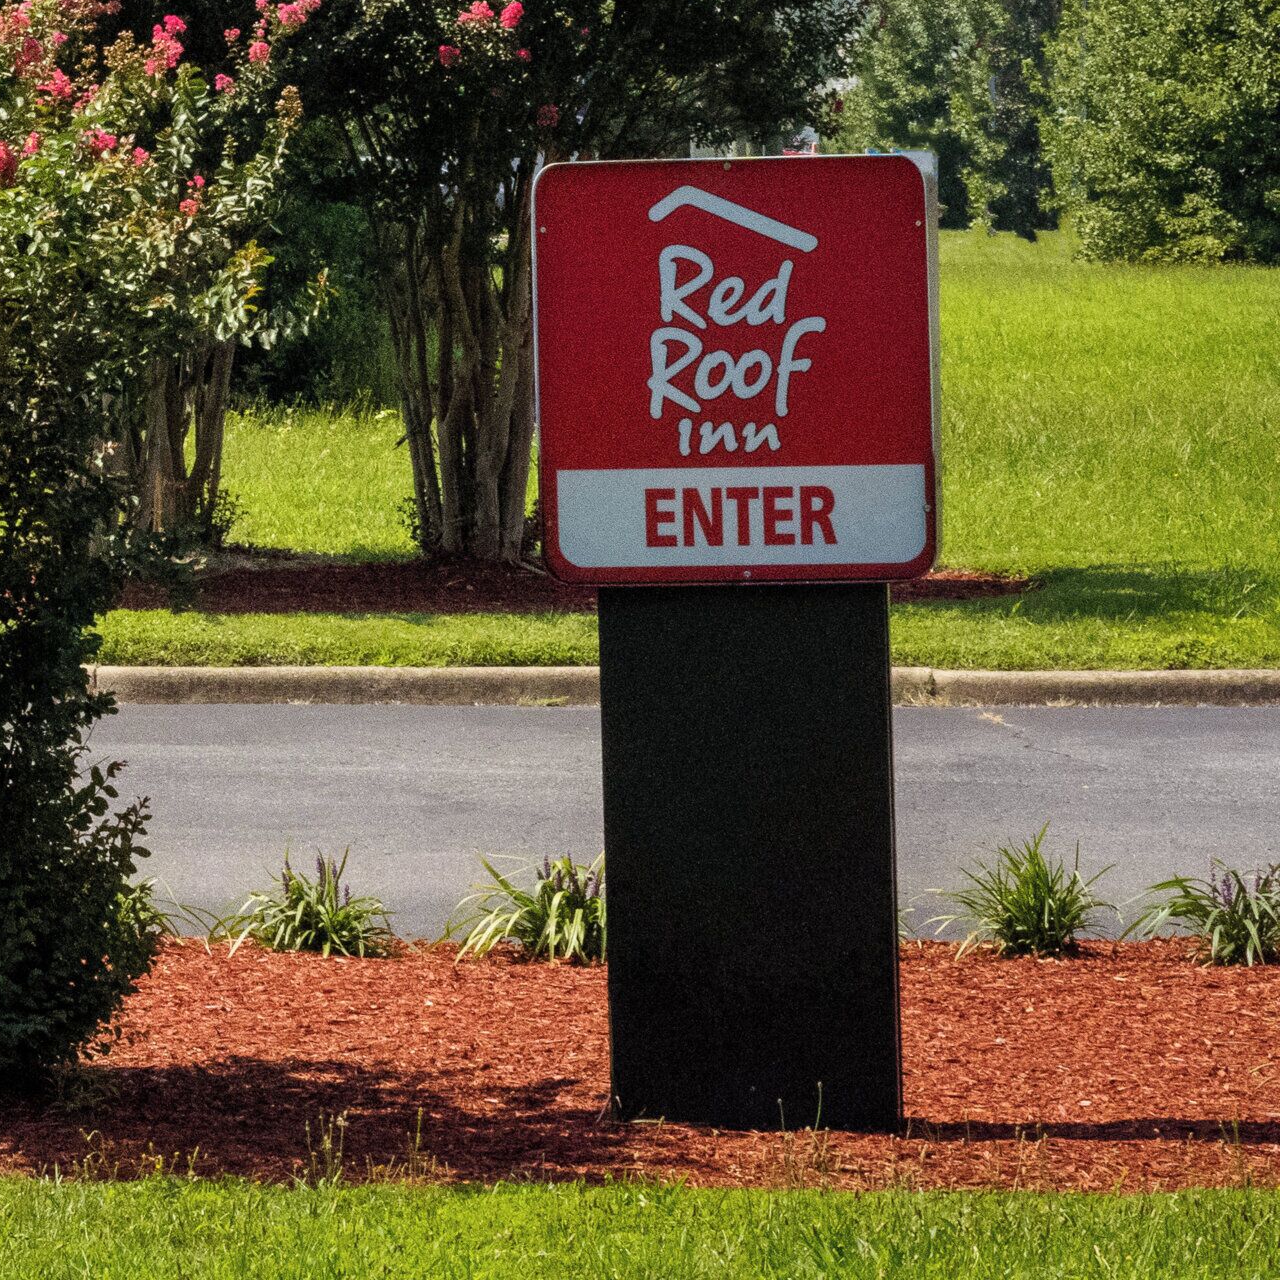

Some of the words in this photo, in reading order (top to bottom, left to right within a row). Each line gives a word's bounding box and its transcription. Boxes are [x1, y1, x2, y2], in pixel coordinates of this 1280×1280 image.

[658, 244, 794, 329] Red
[647, 316, 826, 419] Roof
[644, 485, 838, 549] ENTER
